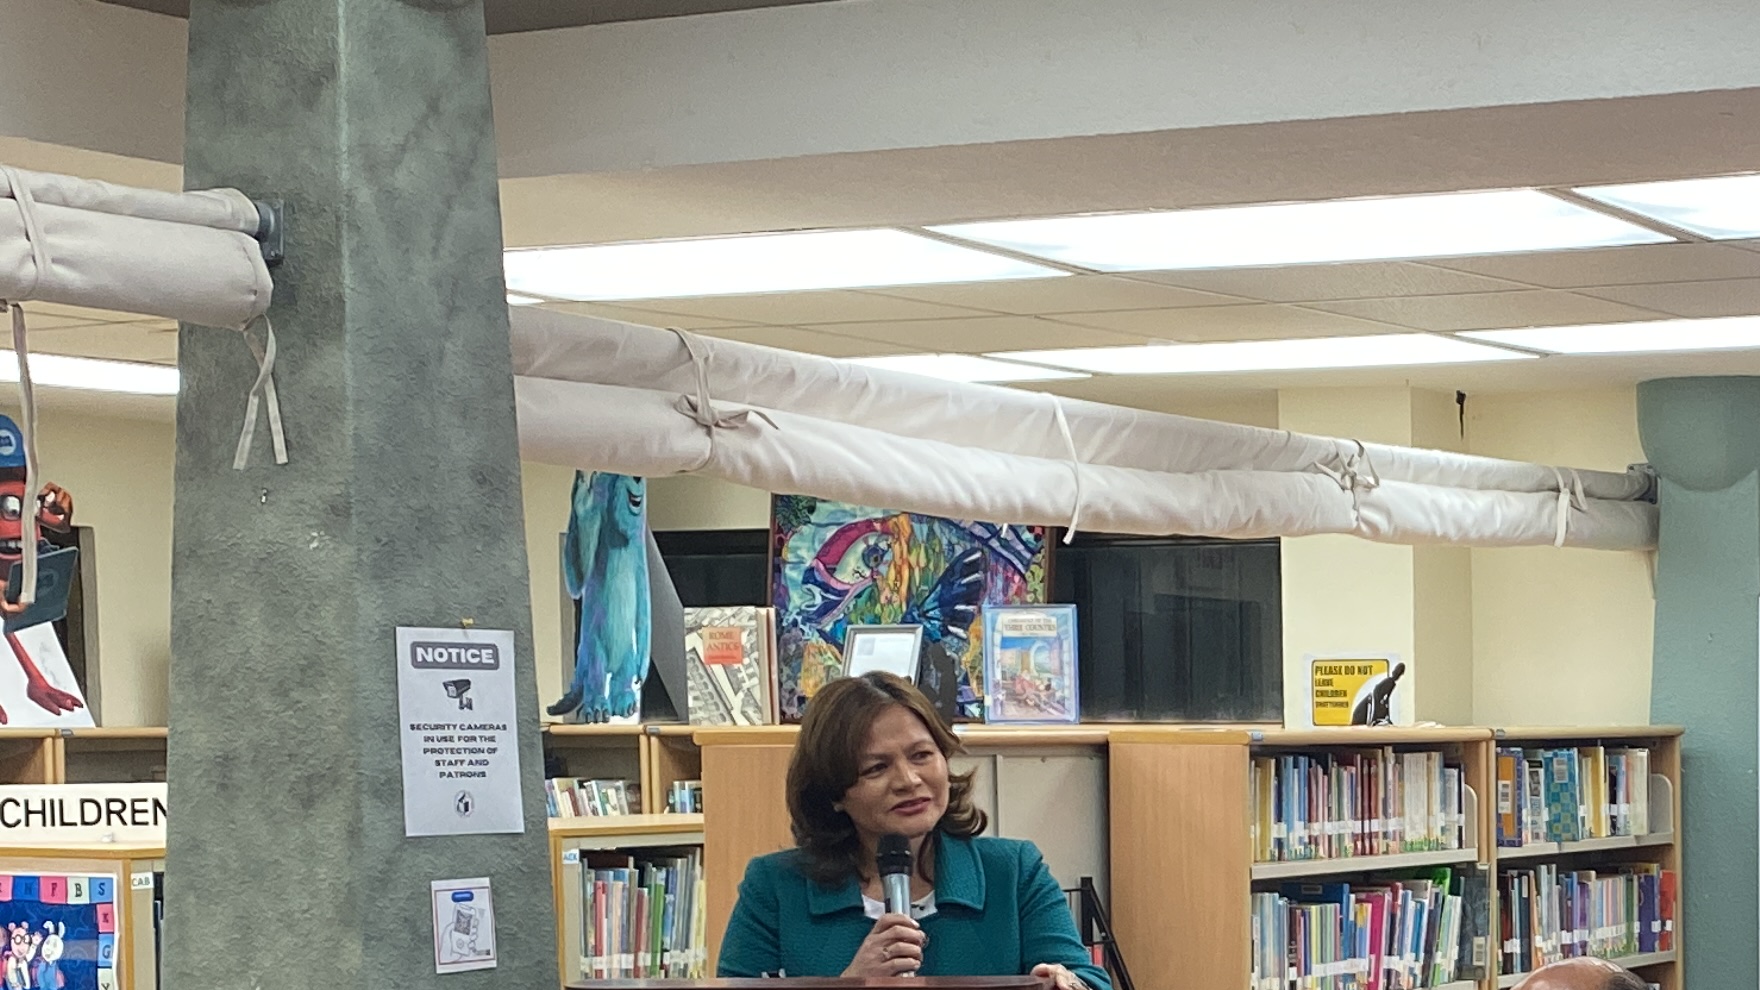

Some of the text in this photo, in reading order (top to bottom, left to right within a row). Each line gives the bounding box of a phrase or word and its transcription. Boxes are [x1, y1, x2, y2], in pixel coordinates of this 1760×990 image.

[708, 632, 733, 640] ROME
[707, 642, 739, 651] ANTICS
[416, 647, 495, 664] NOTICE
[1315, 665, 1373, 675] PLEASE DO NOT
[410, 723, 508, 731] SECURITY CAMERAS
[423, 735, 496, 743] IN USE FOR THE
[423, 747, 499, 755] PROTECTION OF
[434, 759, 490, 767] STAFF AND
[0, 797, 168, 829] CHILDREN
[131, 877, 150, 887] CAB
[74, 883, 83, 898] B
[98, 882, 106, 896] S
